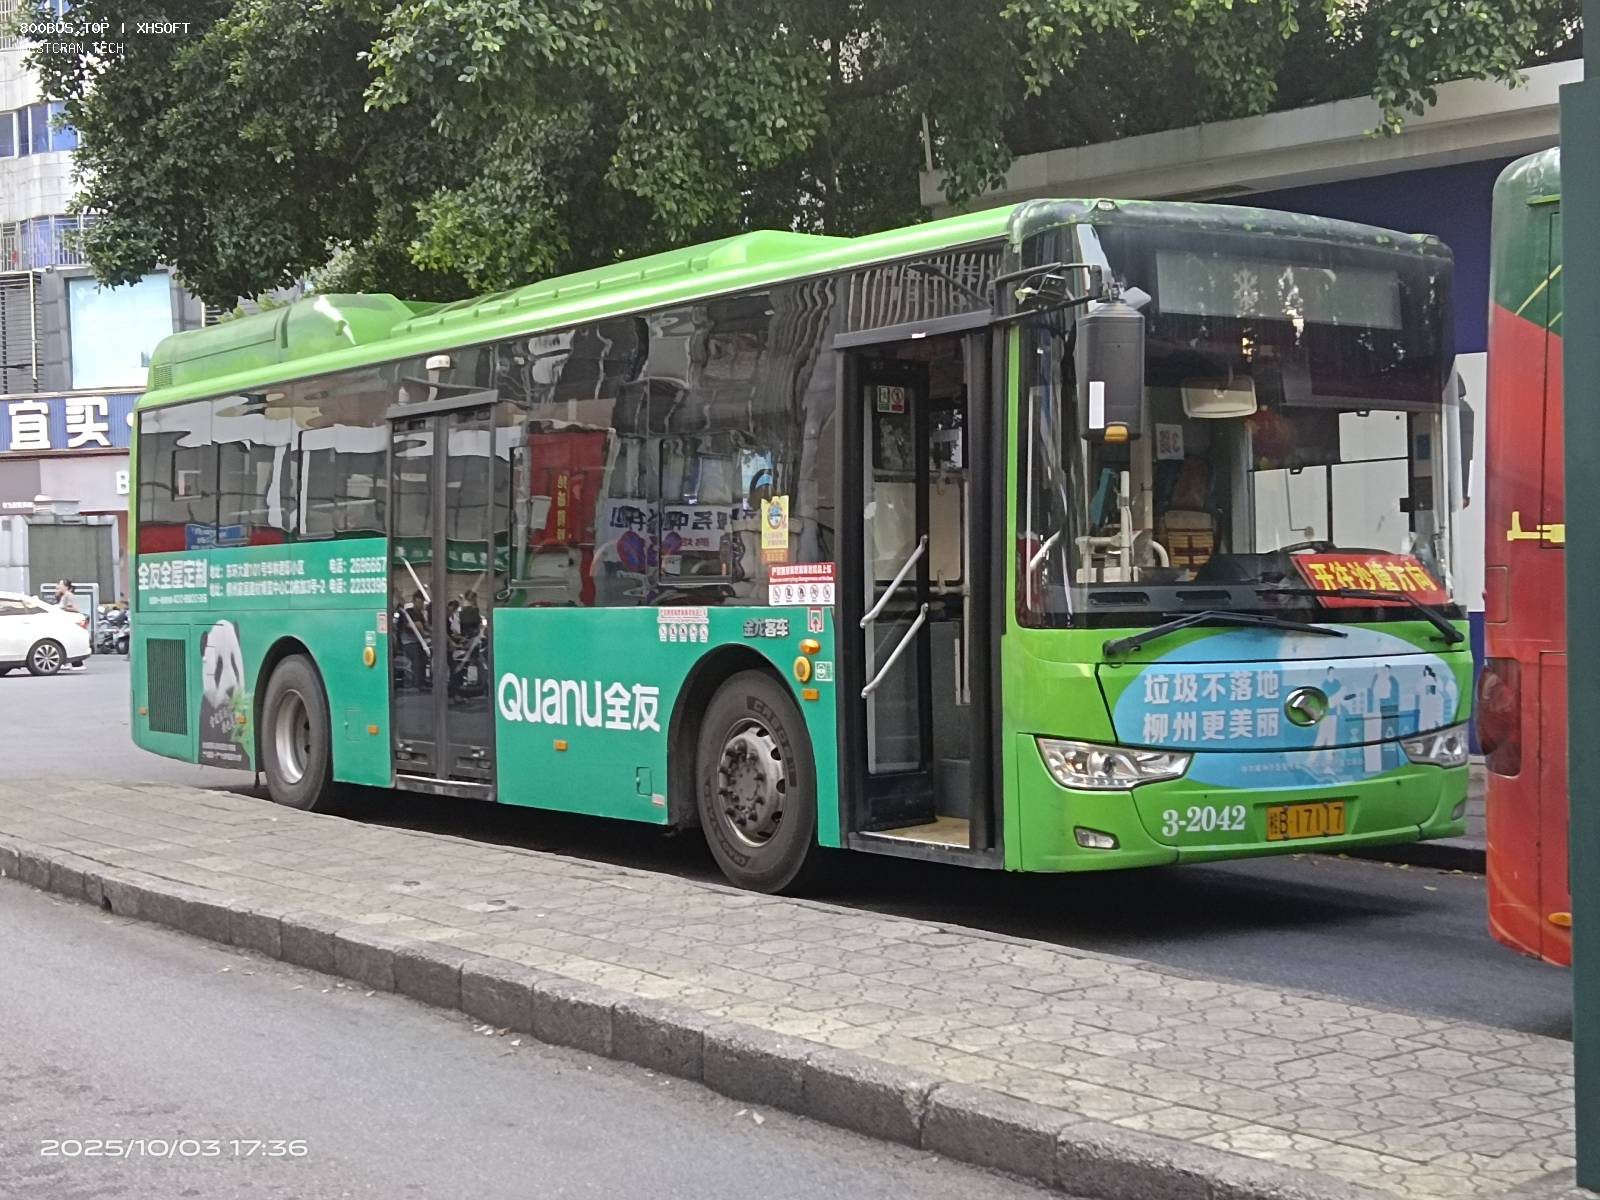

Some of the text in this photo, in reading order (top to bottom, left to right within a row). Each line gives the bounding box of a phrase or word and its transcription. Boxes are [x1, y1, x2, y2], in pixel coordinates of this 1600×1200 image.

[138, 558, 208, 591] 全友全屋定制
[743, 618, 789, 637] 金龙客车
[1143, 669, 1280, 705] 垃圾不落地
[1142, 707, 1280, 744] 柳州更美丽
[1161, 804, 1246, 837] 3-2042
